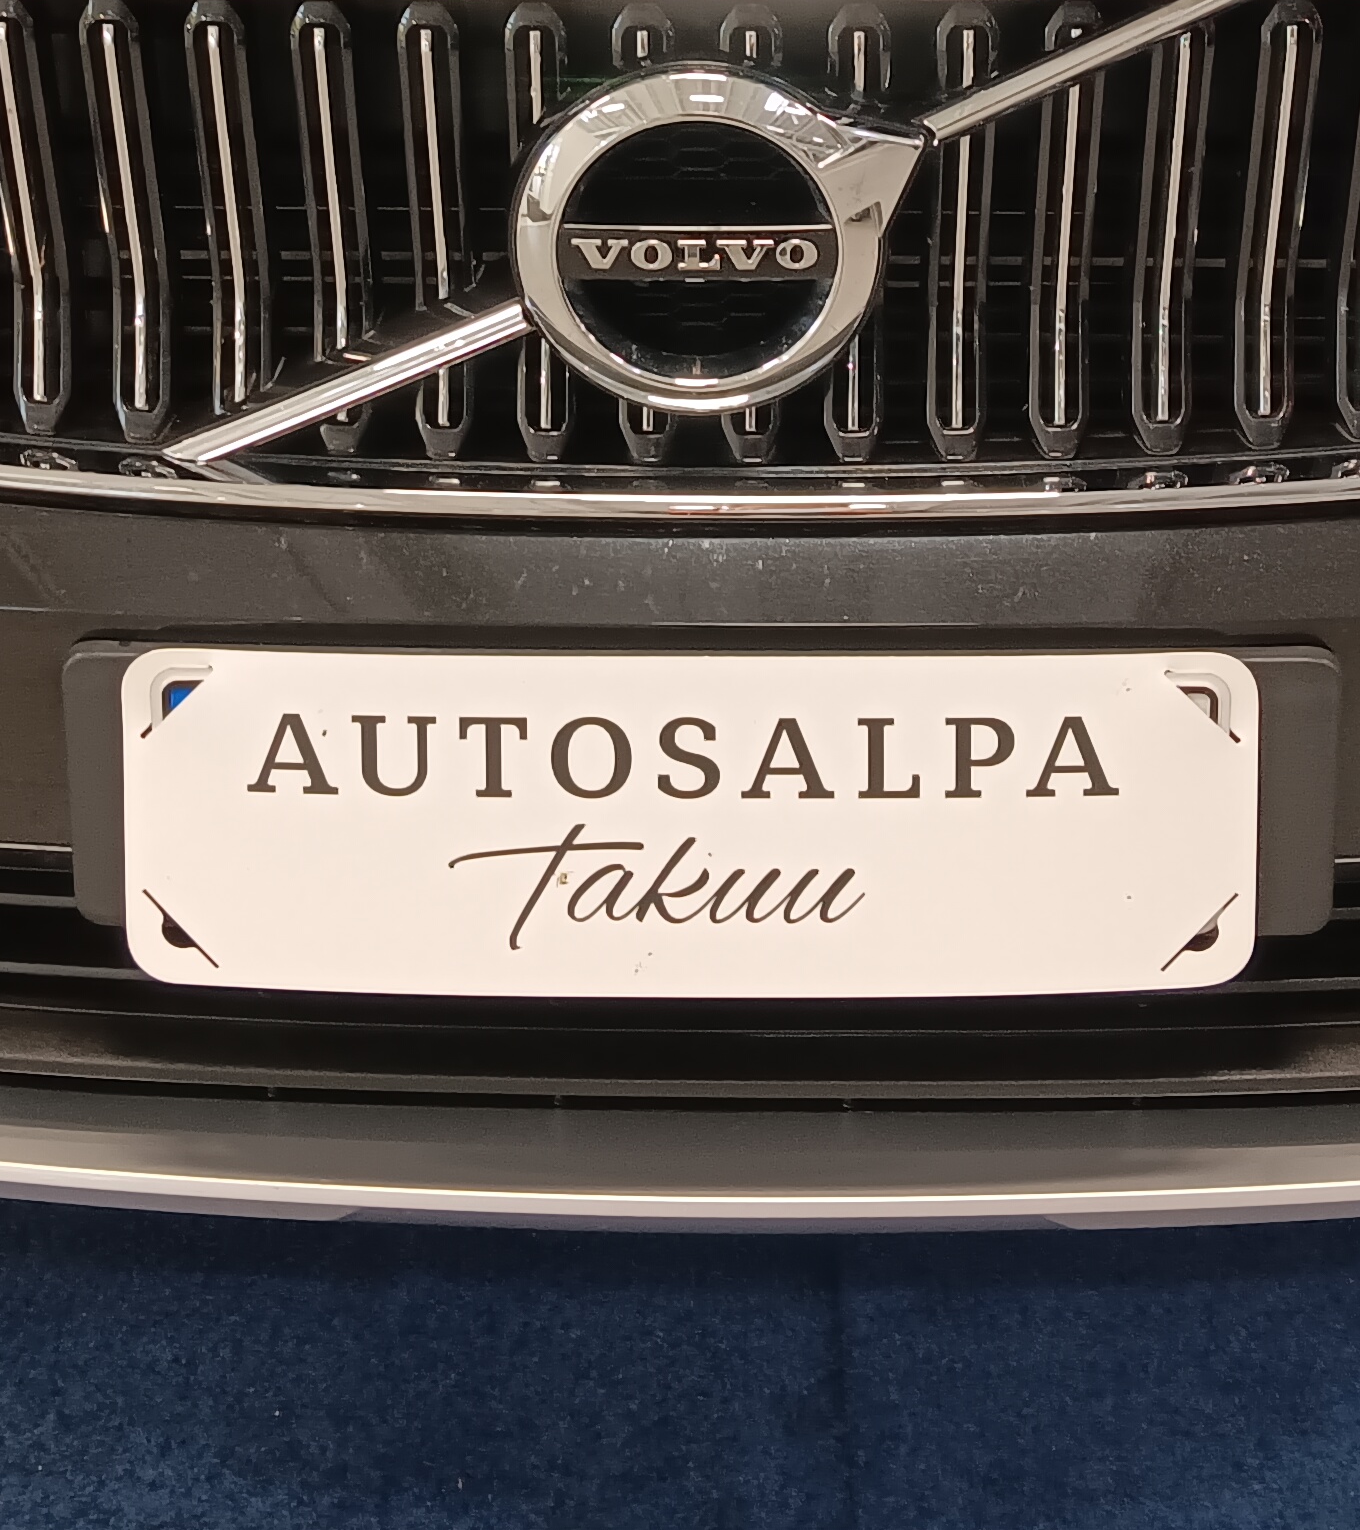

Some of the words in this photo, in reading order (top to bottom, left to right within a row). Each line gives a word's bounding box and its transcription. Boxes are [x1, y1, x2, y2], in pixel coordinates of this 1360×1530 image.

[570, 238, 818, 271] VOLVO
[247, 714, 1120, 800] AUTOSALPA
[449, 824, 866, 950] Takuu
